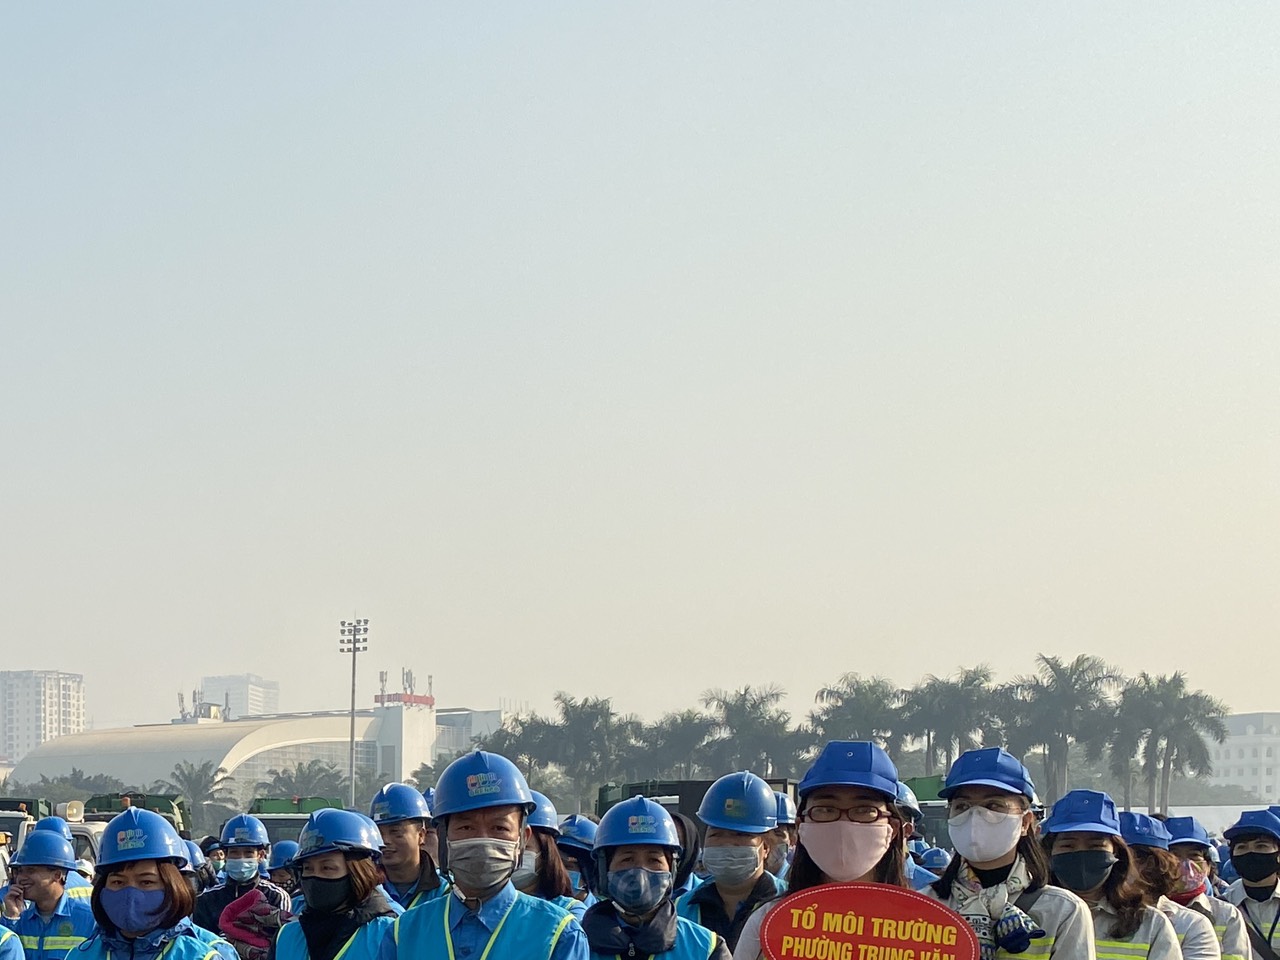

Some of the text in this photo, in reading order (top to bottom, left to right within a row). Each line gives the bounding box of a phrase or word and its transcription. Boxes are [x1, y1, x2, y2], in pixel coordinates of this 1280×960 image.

[790, 903, 958, 946] TỔ MÔI TRƯỜNG
